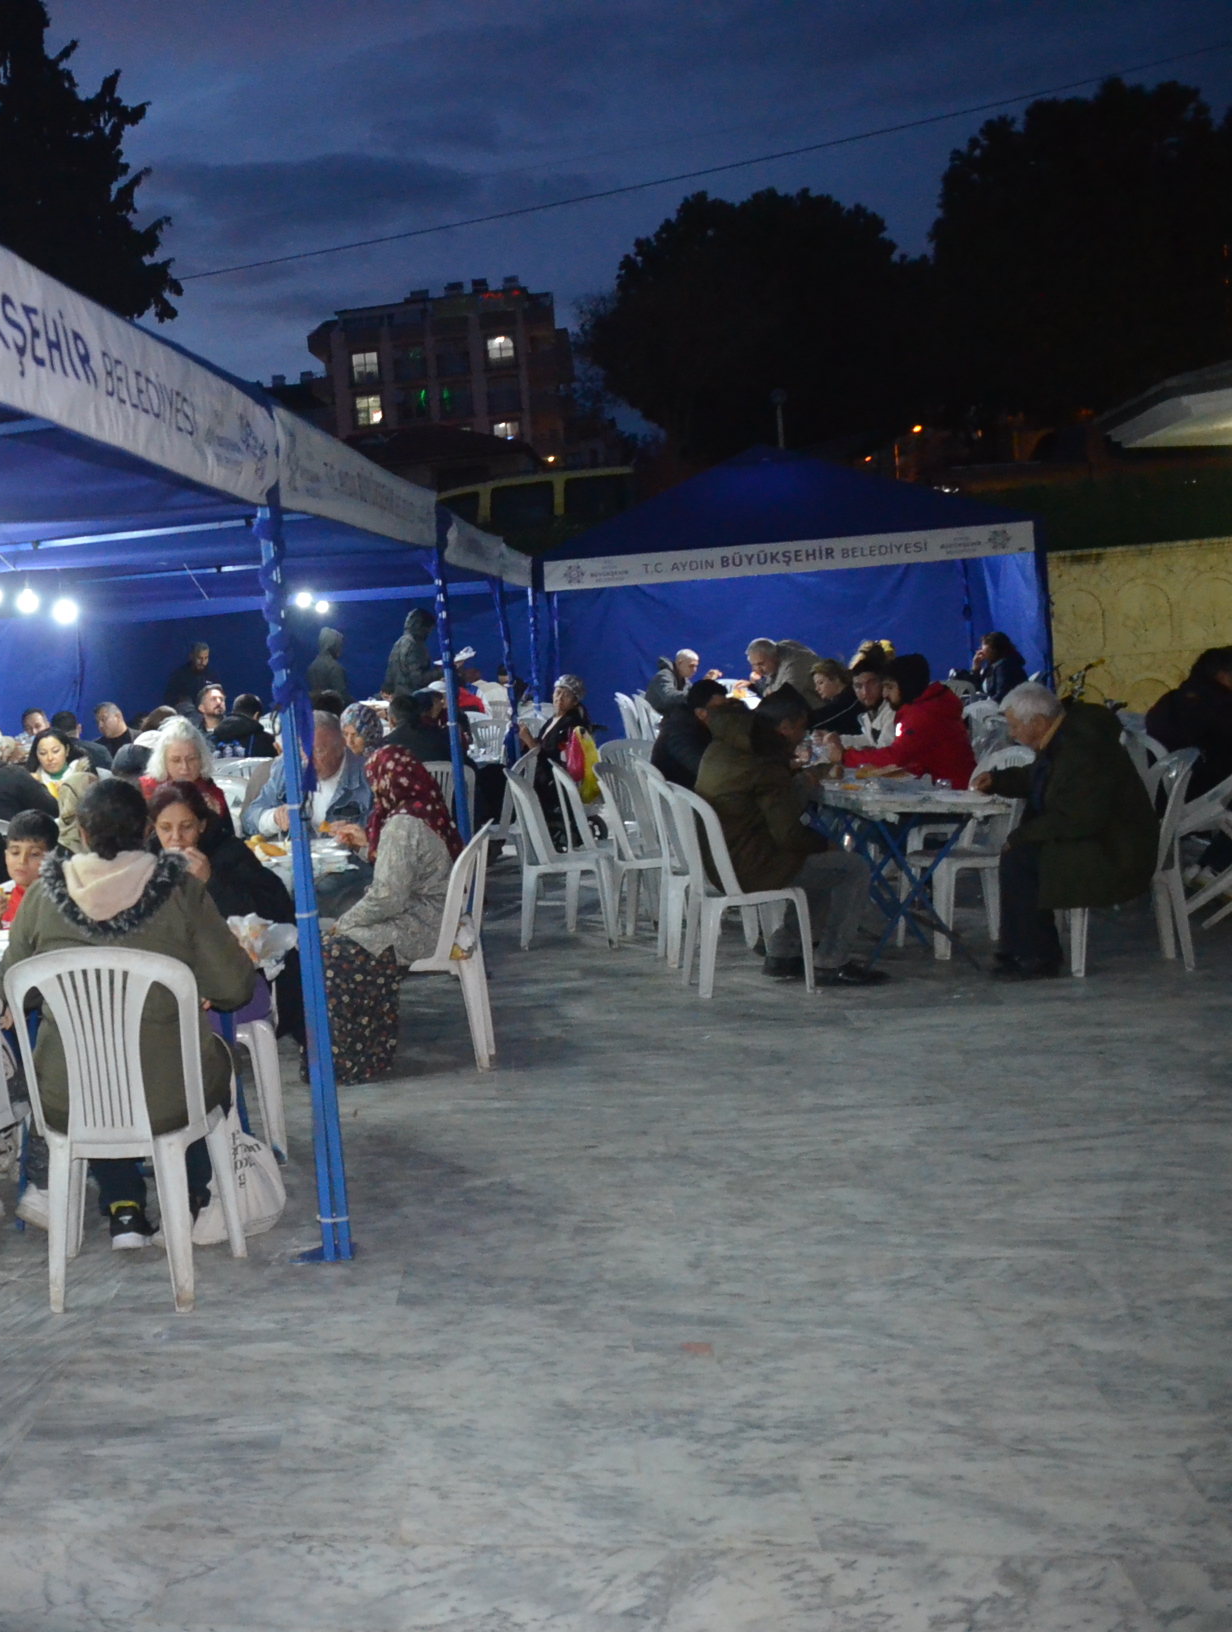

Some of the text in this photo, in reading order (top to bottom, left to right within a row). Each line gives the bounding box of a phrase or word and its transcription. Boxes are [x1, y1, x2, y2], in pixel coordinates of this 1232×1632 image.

[102, 351, 197, 436] BELEDİYESİ
[671, 559, 715, 572] AYDIN
[720, 545, 835, 569] BÜYÜKŞEHİR
[841, 540, 928, 559] BELEDİYESİ
